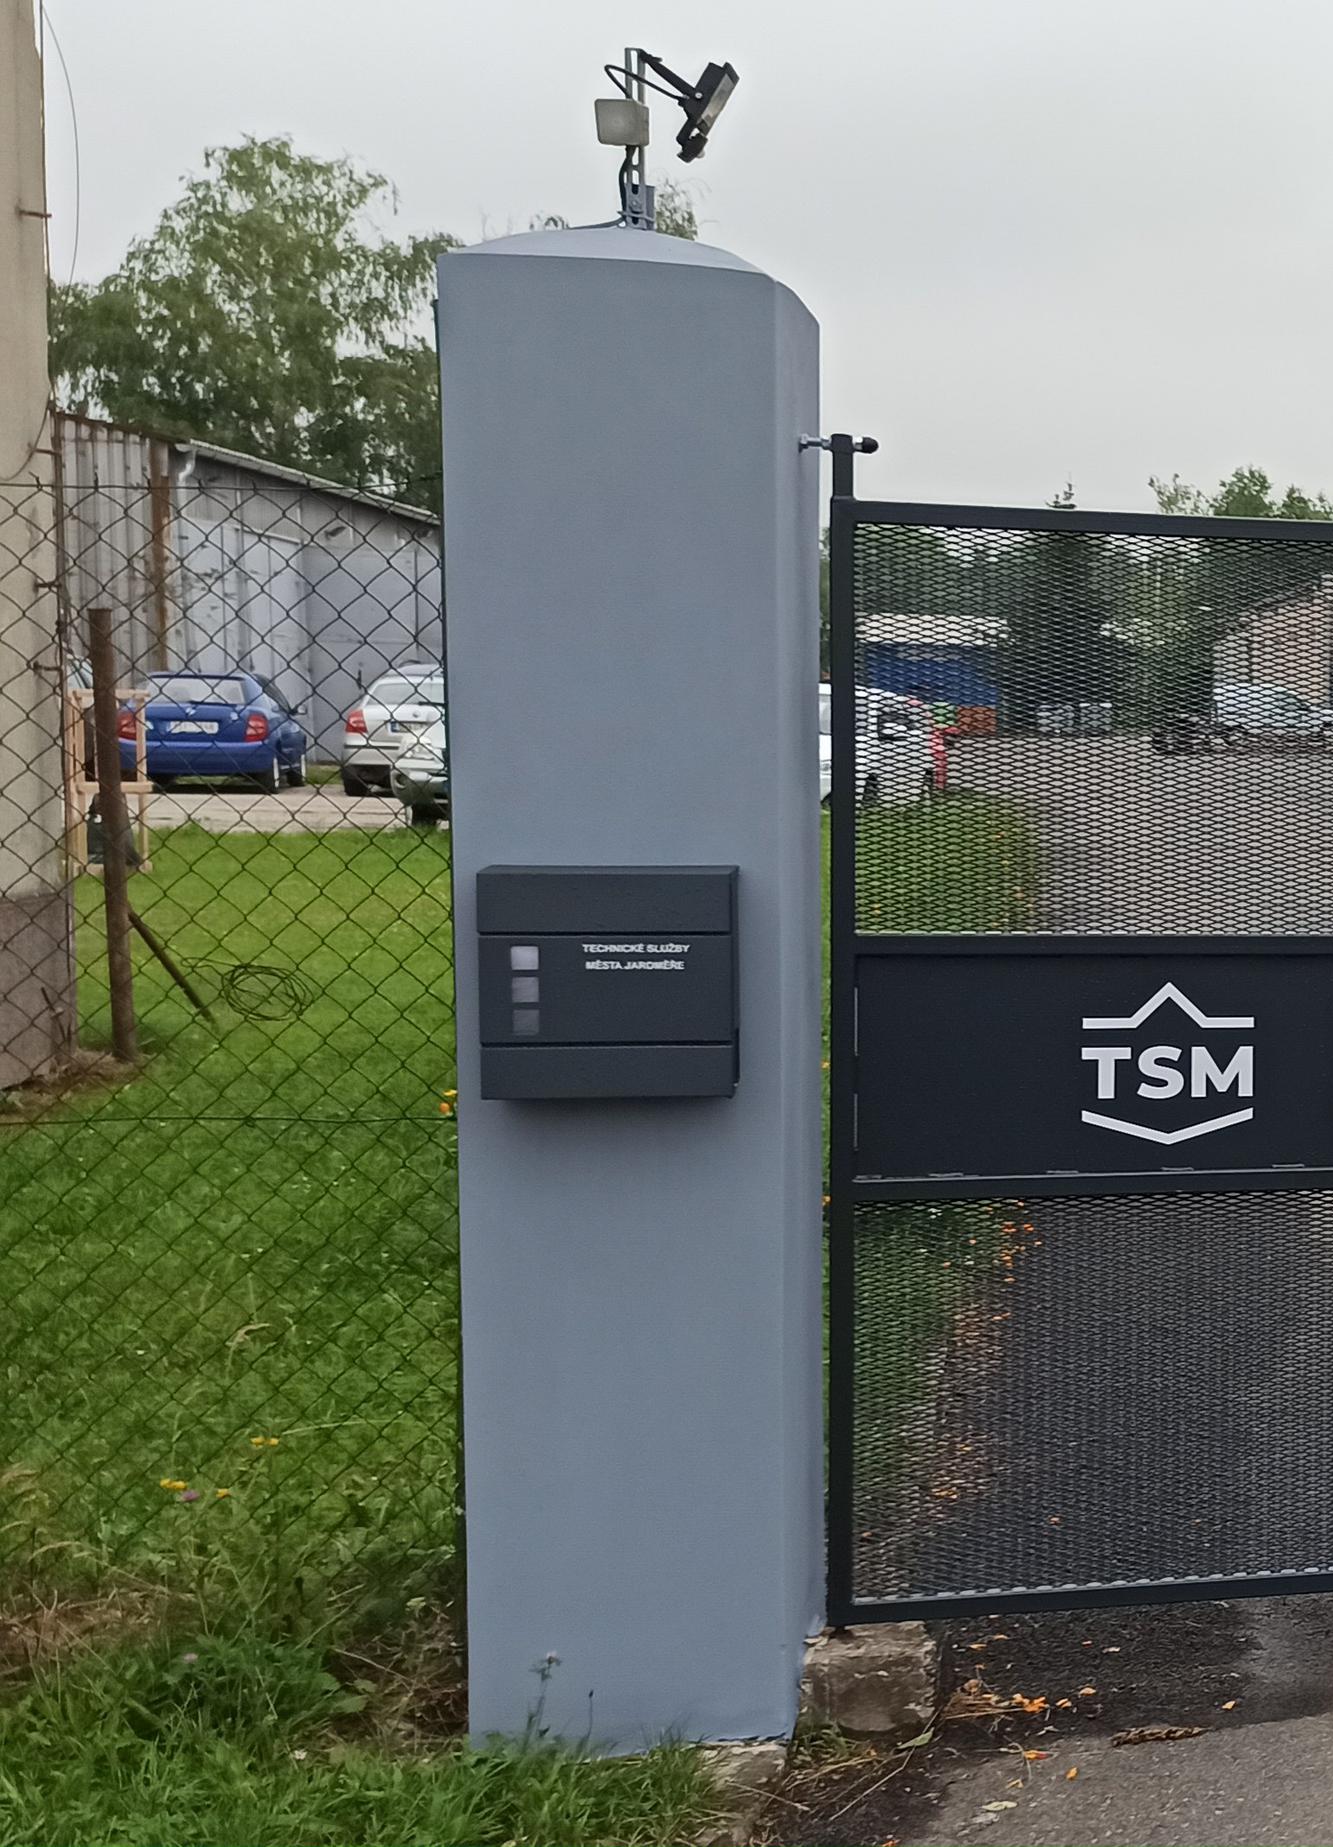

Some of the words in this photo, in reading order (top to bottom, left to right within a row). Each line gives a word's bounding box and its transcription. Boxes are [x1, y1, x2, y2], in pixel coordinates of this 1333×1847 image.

[582, 943, 645, 953] TECHNICKÉ
[646, 942, 690, 953] SLUŽBY
[585, 959, 622, 970] MĚSTA
[623, 959, 685, 970] JAROMĚŘE
[1081, 1045, 1254, 1099] TSM
